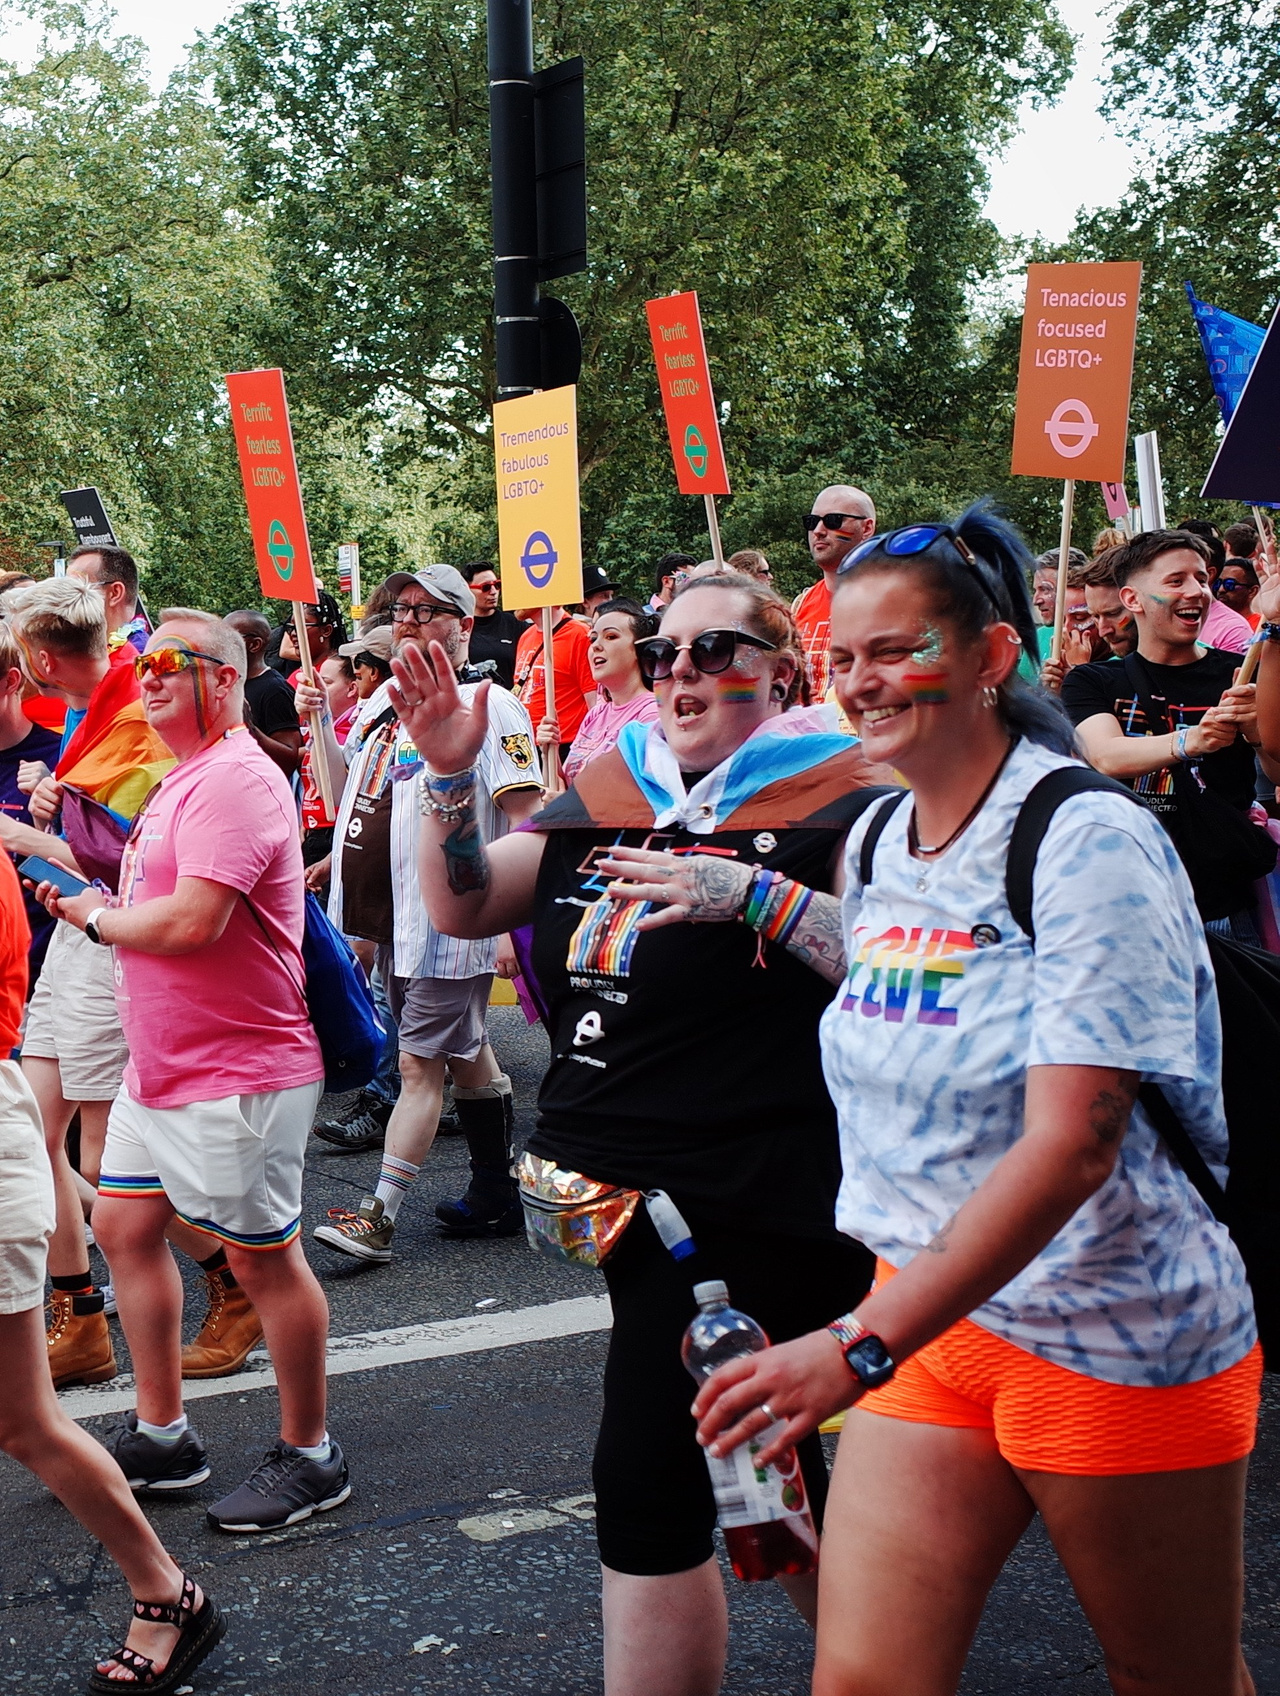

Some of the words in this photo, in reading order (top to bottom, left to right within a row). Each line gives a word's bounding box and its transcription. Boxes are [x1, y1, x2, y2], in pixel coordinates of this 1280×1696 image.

[1040, 288, 1127, 308] Tenacious
[659, 322, 689, 342] Terrific
[1037, 319, 1106, 338] focused
[664, 352, 696, 370] fearless
[1035, 348, 1103, 369] LGBTQ+
[669, 378, 700, 397] LGBTQ+
[240, 402, 273, 423] Terrific
[500, 421, 569, 448] Tremendous
[246, 435, 281, 455] fearless
[501, 452, 549, 474] fabulous
[251, 467, 286, 487] LGBTQ+
[503, 478, 545, 500] LGBTQ+
[840, 926, 977, 1027] LOVE
